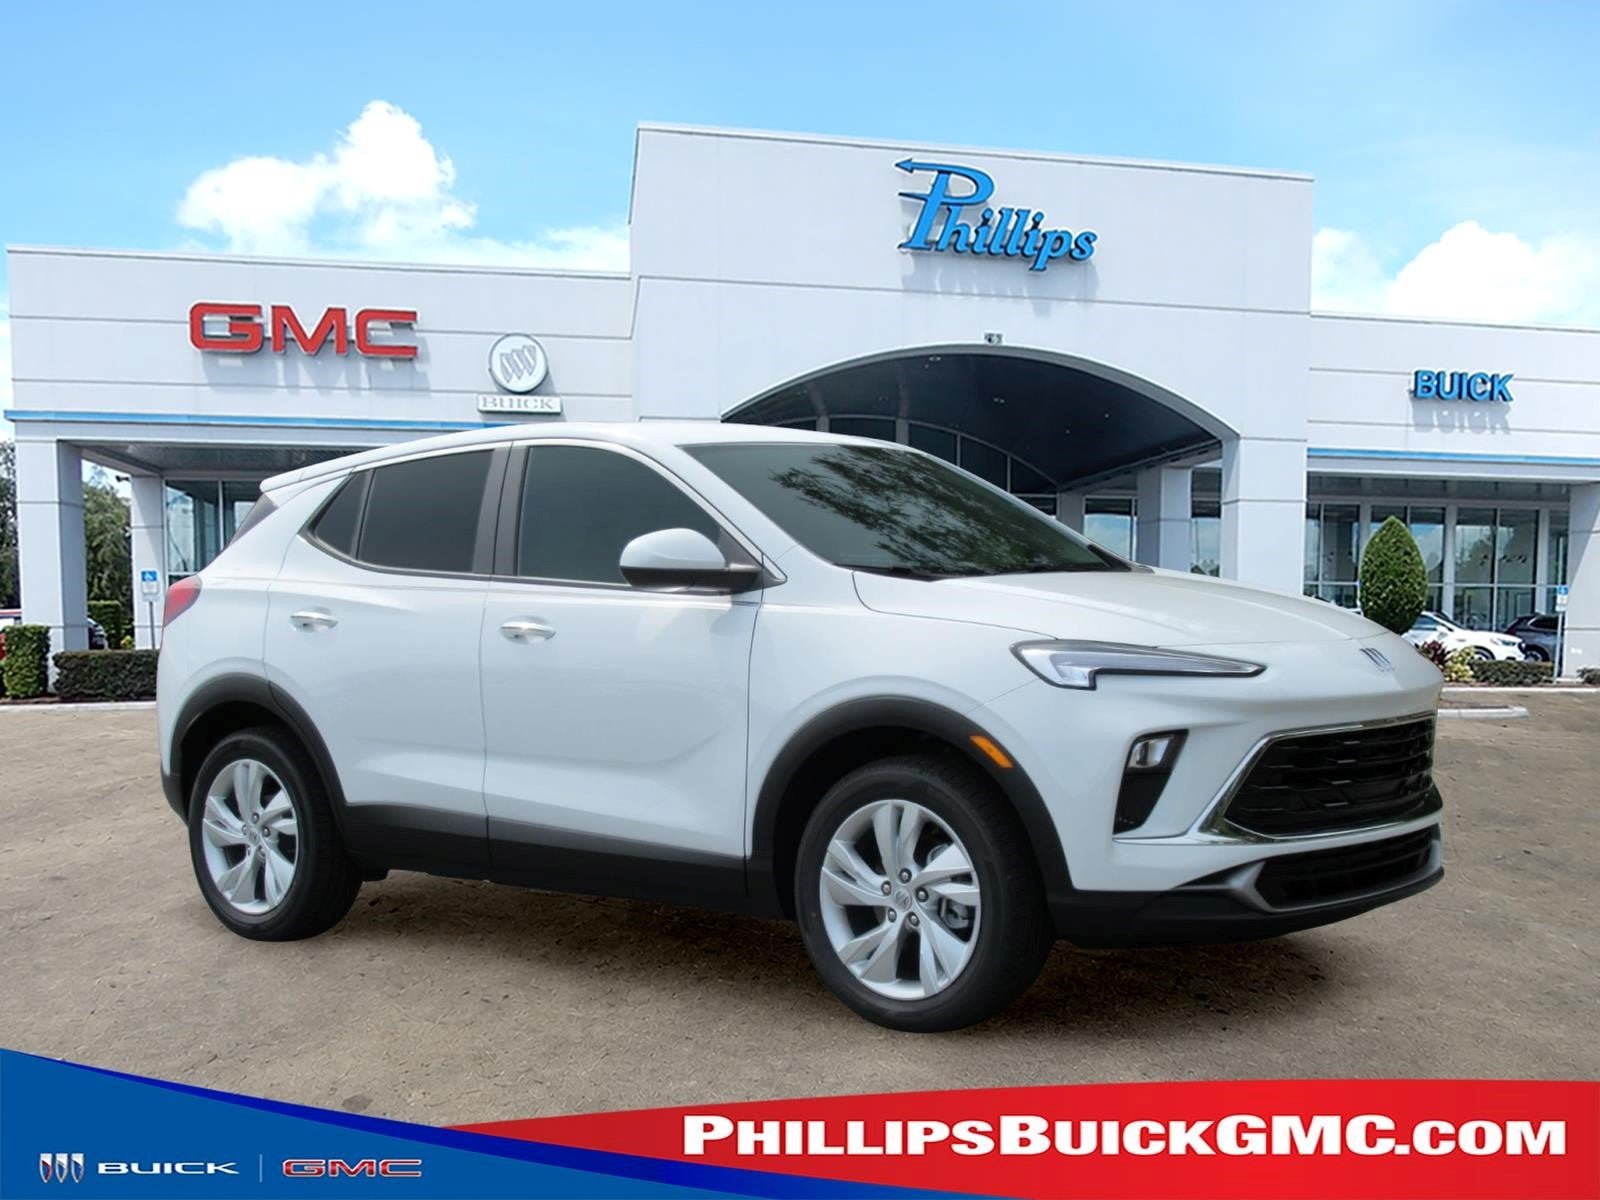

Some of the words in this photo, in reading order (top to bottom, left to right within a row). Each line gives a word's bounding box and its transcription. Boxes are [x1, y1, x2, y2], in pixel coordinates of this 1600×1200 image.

[894, 158, 1098, 271] Phillips
[189, 301, 419, 360] GMC
[481, 395, 555, 411] BUICK
[1413, 369, 1514, 402] BUICK
